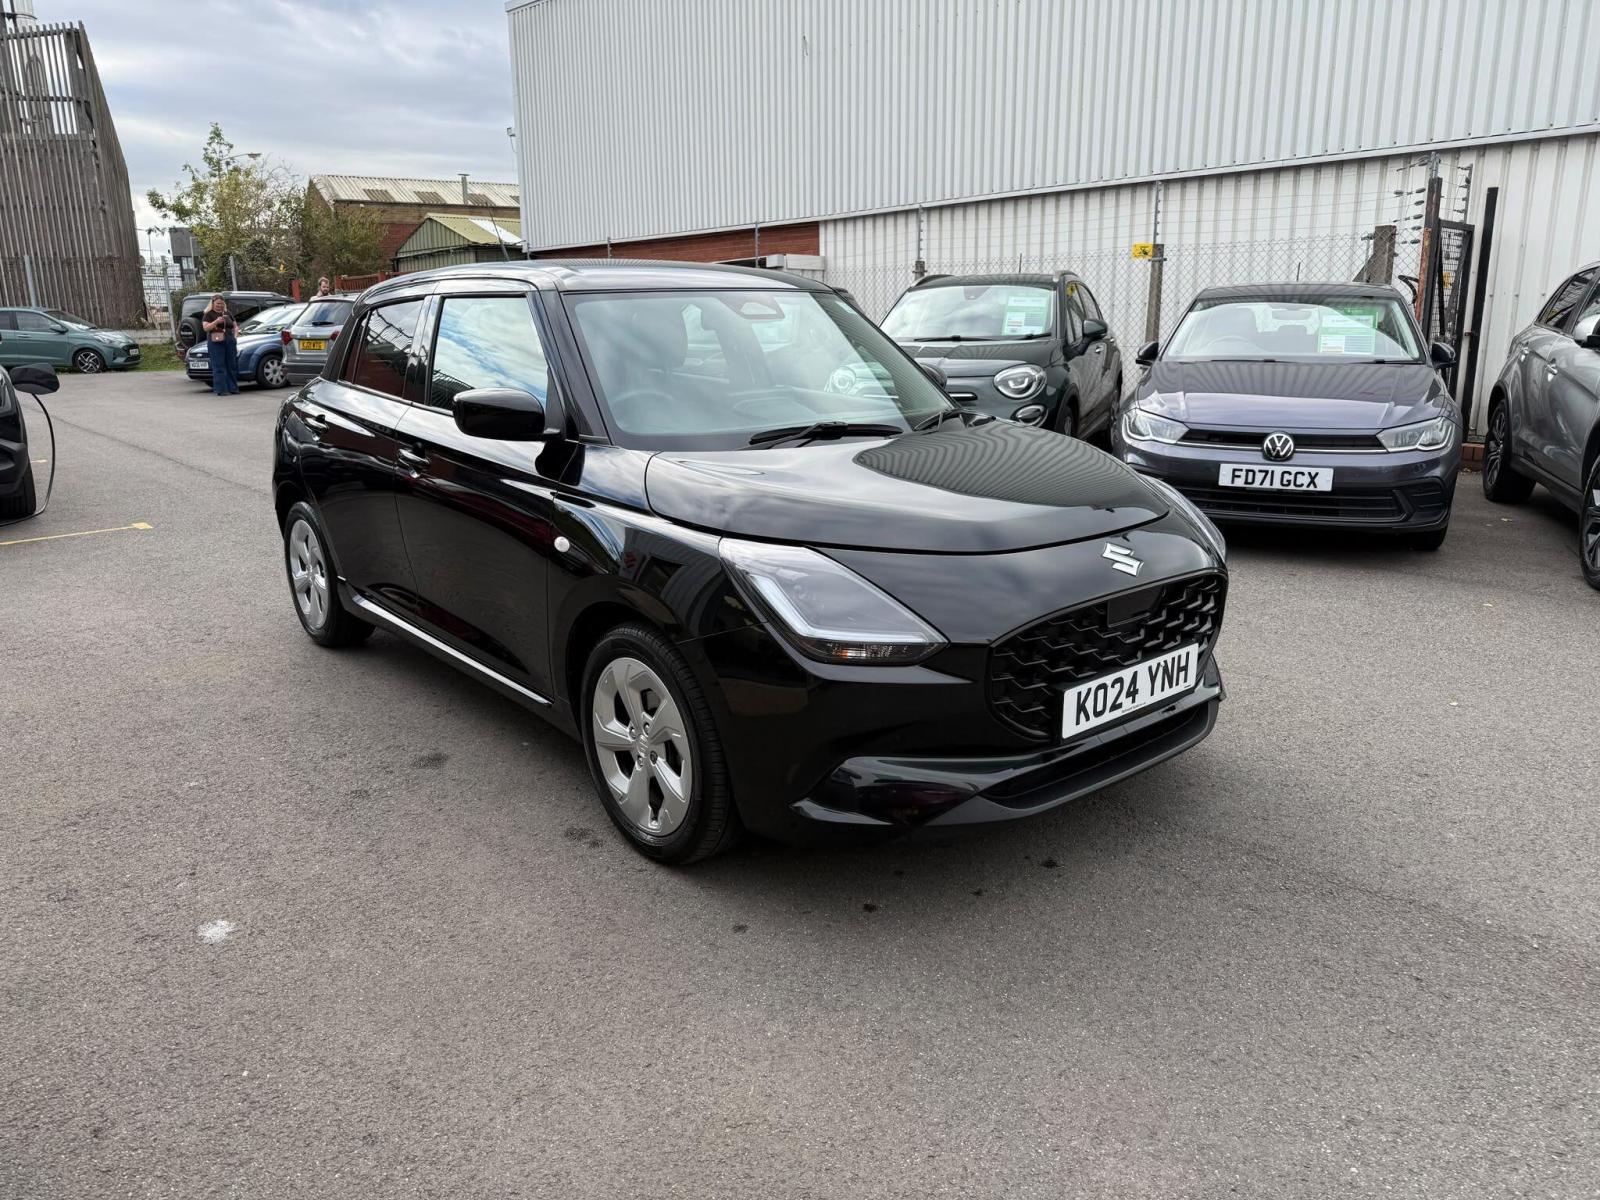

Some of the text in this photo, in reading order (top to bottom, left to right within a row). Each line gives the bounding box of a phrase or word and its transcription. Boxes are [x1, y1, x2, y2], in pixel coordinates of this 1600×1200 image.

[1230, 468, 1319, 489] FD71 GCX
[1147, 651, 1190, 697] YNH
